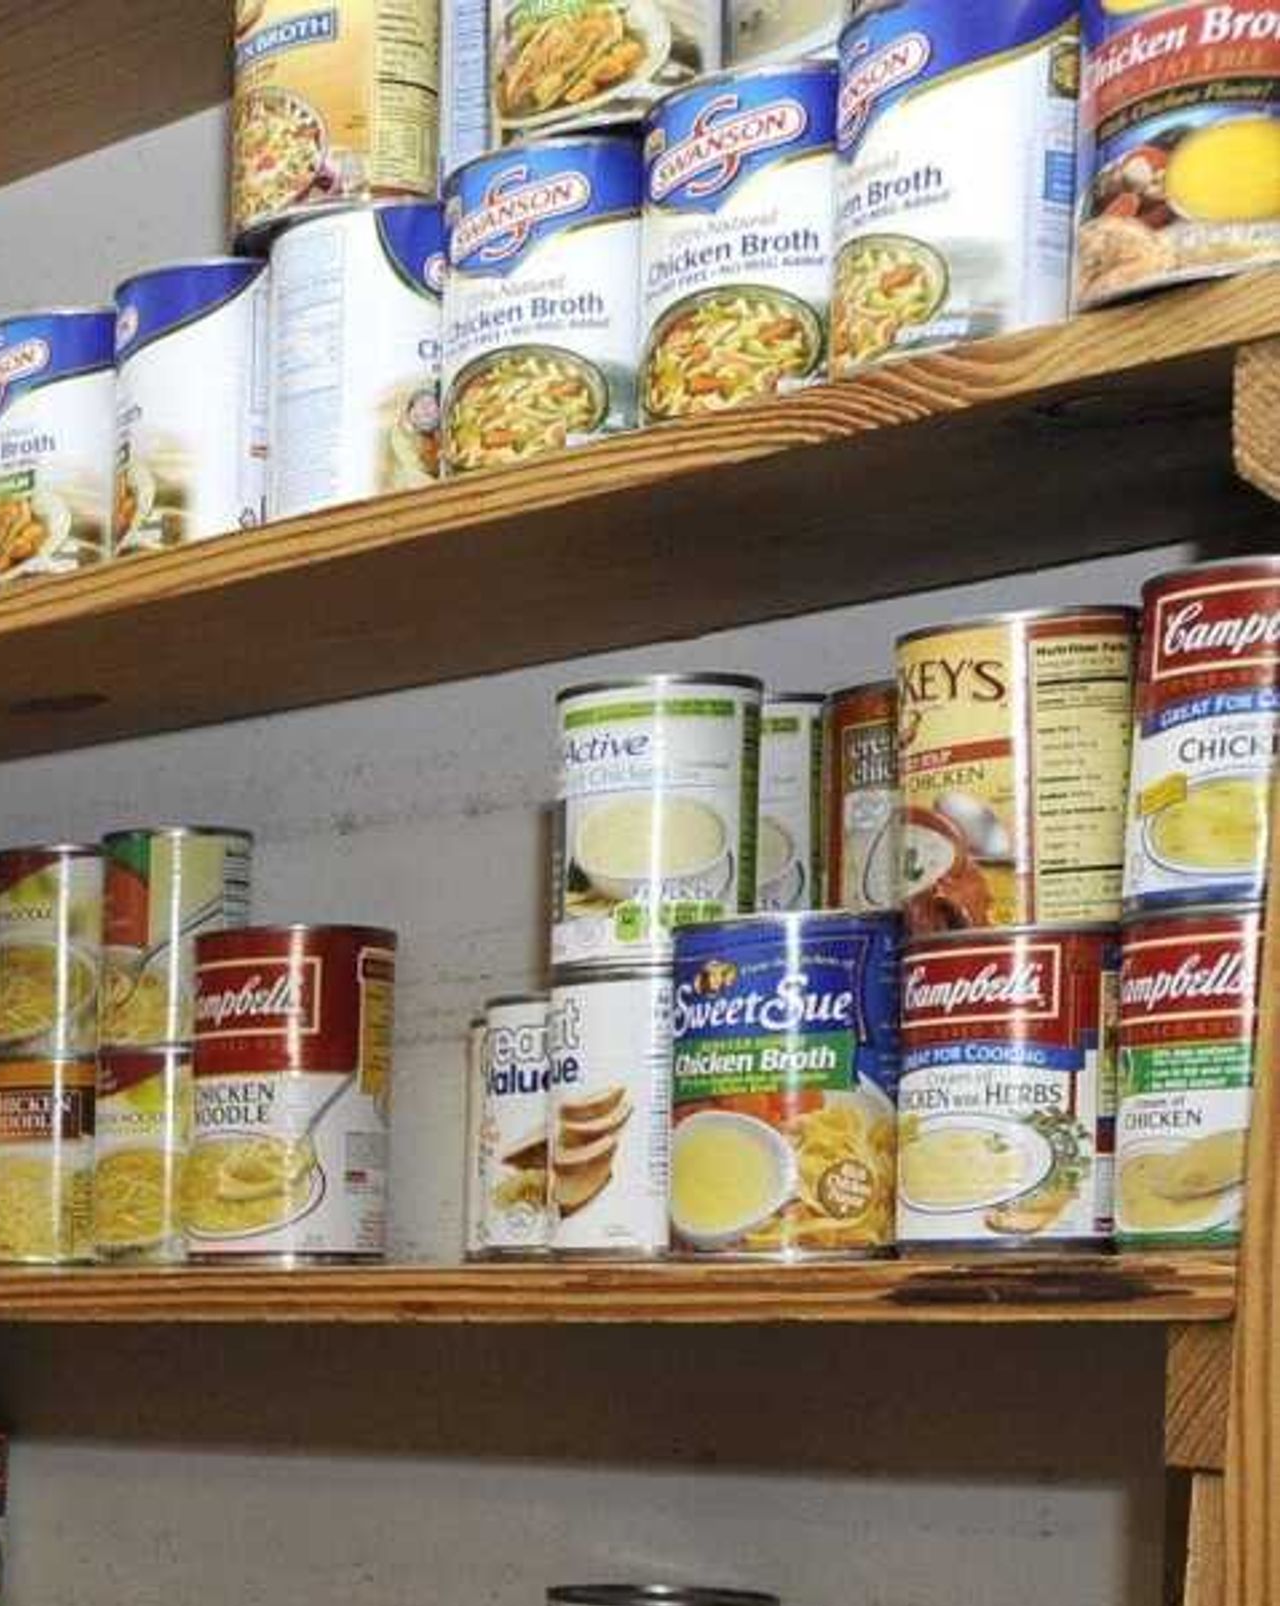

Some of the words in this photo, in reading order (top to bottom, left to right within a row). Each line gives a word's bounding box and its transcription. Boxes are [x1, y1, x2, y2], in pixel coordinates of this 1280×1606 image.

[658, 109, 788, 181] SWANSON
[867, 165, 943, 202] Broth
[454, 182, 574, 247] SWANSON
[648, 242, 731, 285] Chicken
[740, 228, 820, 255] Broth
[530, 291, 604, 320] Broth
[673, 983, 763, 1038] Sweet
[759, 973, 854, 1031] Sue
[675, 1048, 754, 1075] Chicken
[761, 1044, 838, 1071] Broth
[984, 1082, 1063, 1107] HERBS
[1124, 1108, 1203, 1132] CHICKEN
